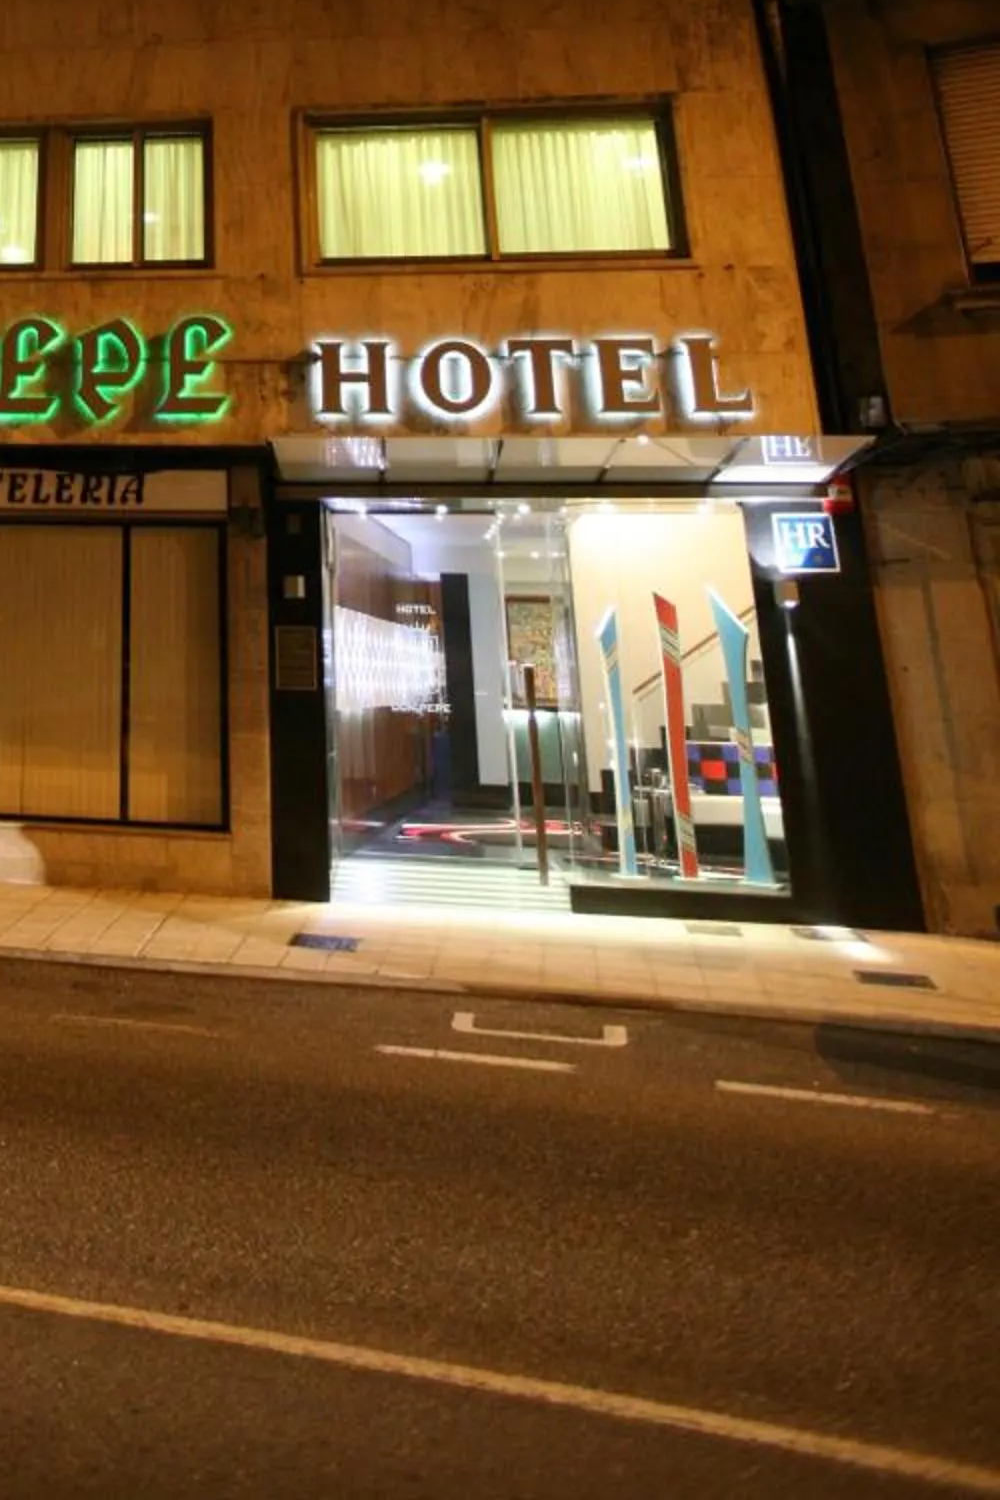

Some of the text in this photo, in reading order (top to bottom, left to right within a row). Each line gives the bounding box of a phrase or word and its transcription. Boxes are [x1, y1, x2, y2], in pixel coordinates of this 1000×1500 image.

[312, 337, 756, 419] HOTEL
[780, 521, 830, 549] HR
[395, 604, 436, 615] HOTEL
